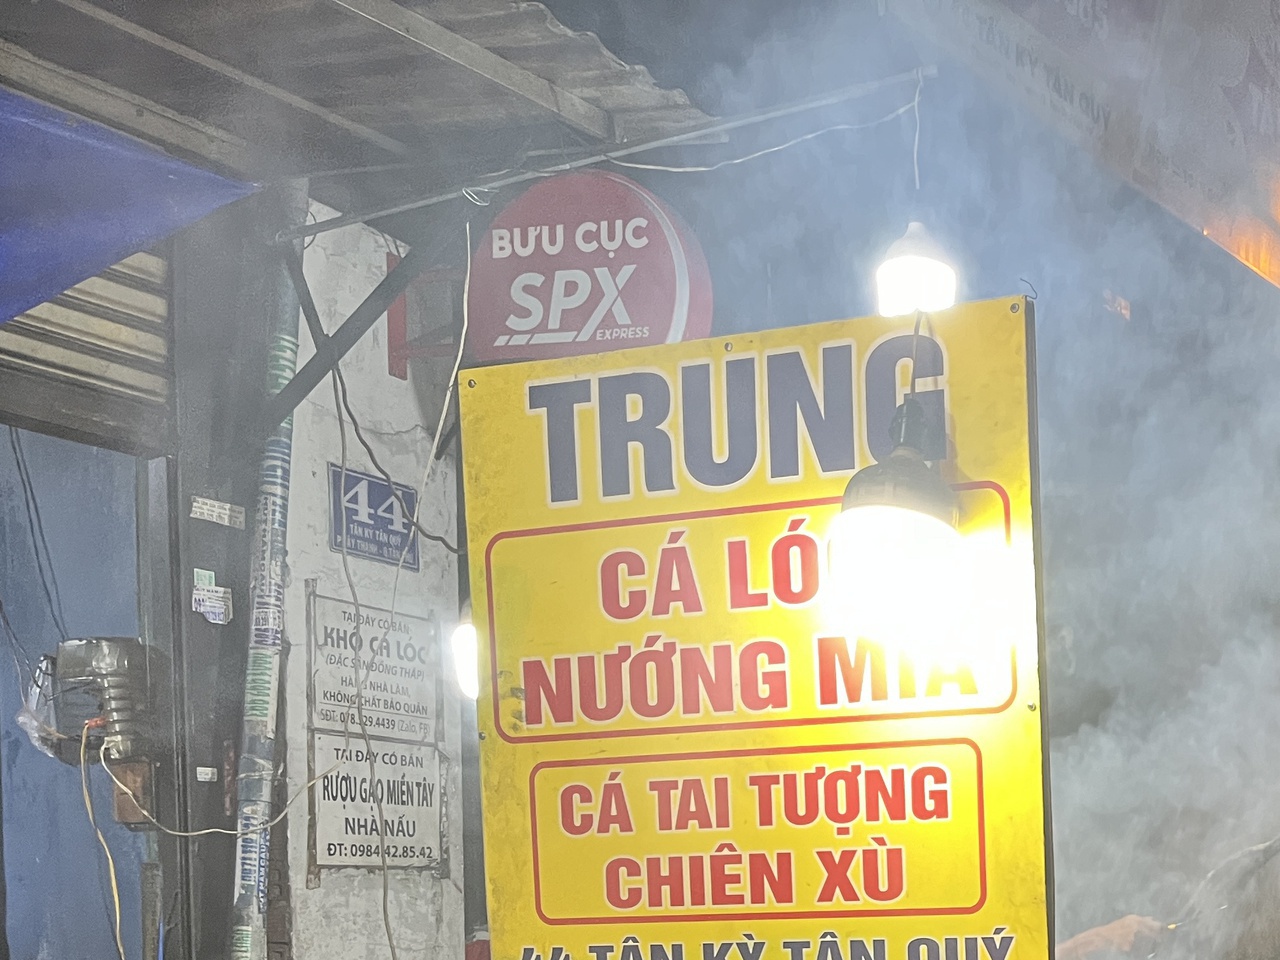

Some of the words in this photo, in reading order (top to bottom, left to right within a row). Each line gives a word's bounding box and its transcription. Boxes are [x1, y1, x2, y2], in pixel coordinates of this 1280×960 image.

[492, 224, 564, 259] BƯU
[575, 217, 649, 258] CỤC
[505, 264, 637, 342] SPX
[596, 326, 649, 340] EXPRESS
[528, 335, 947, 503] TRUNG
[342, 479, 409, 534] 44
[600, 531, 702, 620] CÁ
[727, 518, 822, 610] LÓ
[358, 613, 377, 628] ĐÂY
[396, 636, 426, 665] LÓC
[340, 675, 367, 690] HÀ
[369, 679, 389, 694] NHÀ
[521, 634, 788, 725] NƯỚNG
[381, 750, 398, 766] CÓ
[400, 752, 424, 769] BÁN
[322, 770, 357, 810] RƯỢU
[359, 777, 384, 812] GẠO
[415, 776, 435, 808] TÂY
[559, 771, 634, 836] CÁ
[649, 776, 730, 831] TAI
[749, 763, 950, 836] TƯỢNG
[344, 814, 381, 837] NHÀ
[384, 813, 416, 838] NẤU
[326, 842, 348, 857] ĐT:
[350, 843, 433, 859] 098442.85.42
[605, 842, 793, 909] CHIÊN
[816, 836, 905, 904] XÙ
